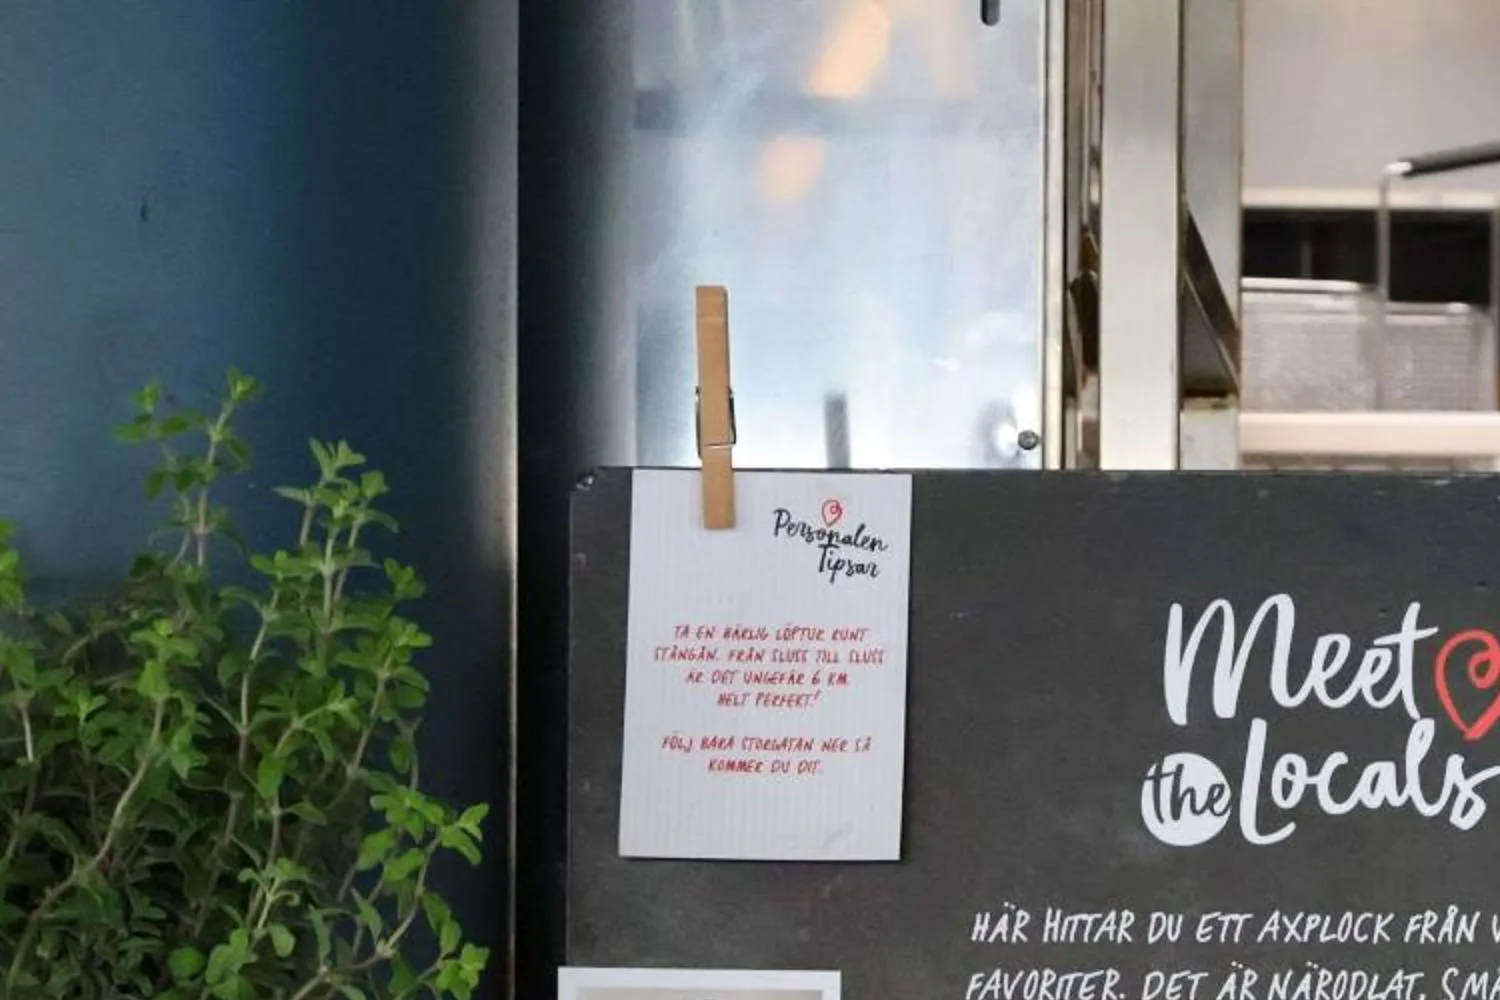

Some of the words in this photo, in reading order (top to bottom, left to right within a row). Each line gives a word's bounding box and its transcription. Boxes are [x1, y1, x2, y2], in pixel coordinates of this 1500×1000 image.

[773, 507, 888, 552] Personalen
[818, 544, 880, 584] Tipsar
[1163, 592, 1440, 726] Meet
[1143, 761, 1231, 824] the
[971, 901, 1029, 943] HÄR
[1042, 907, 1135, 943] HITTAR
[1147, 911, 1183, 944] DU
[1196, 912, 1254, 942] ETT
[1257, 910, 1395, 944] AXPLOCK
[1404, 905, 1481, 944] FRÅN
